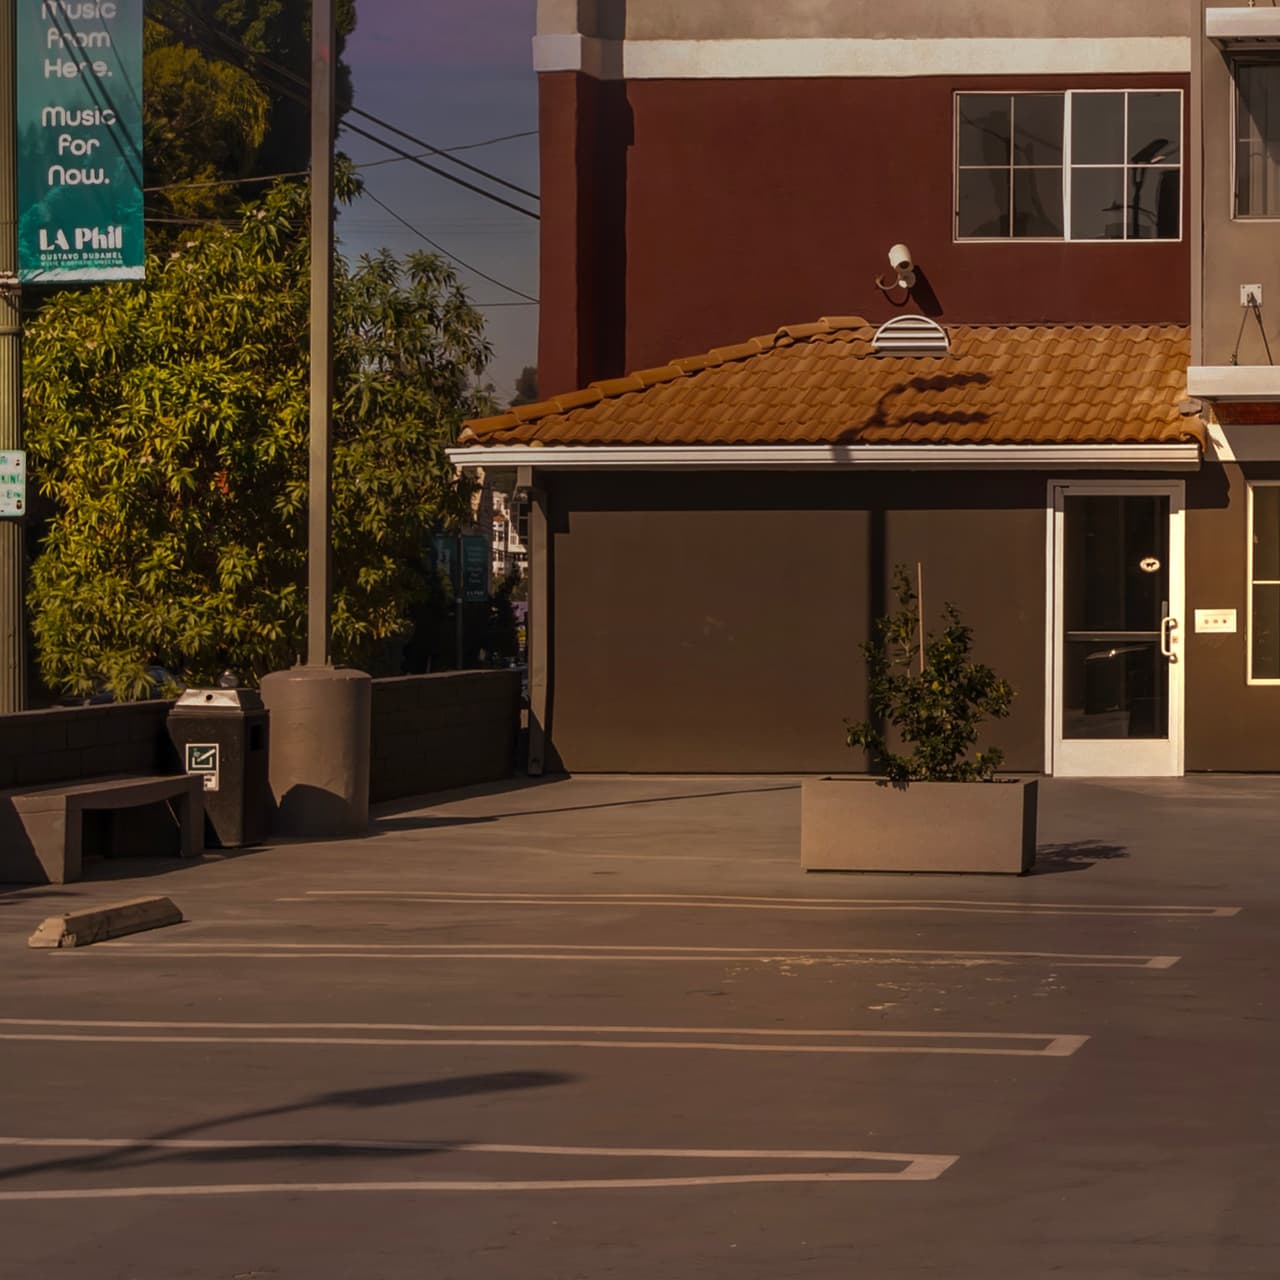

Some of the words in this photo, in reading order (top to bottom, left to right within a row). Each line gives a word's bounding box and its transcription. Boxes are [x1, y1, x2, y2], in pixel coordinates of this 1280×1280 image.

[47, 30, 111, 49] from
[44, 59, 112, 79] Here.
[42, 105, 116, 127] Music
[58, 135, 100, 156] for
[39, 228, 70, 250] LA
[75, 225, 122, 250] Phil
